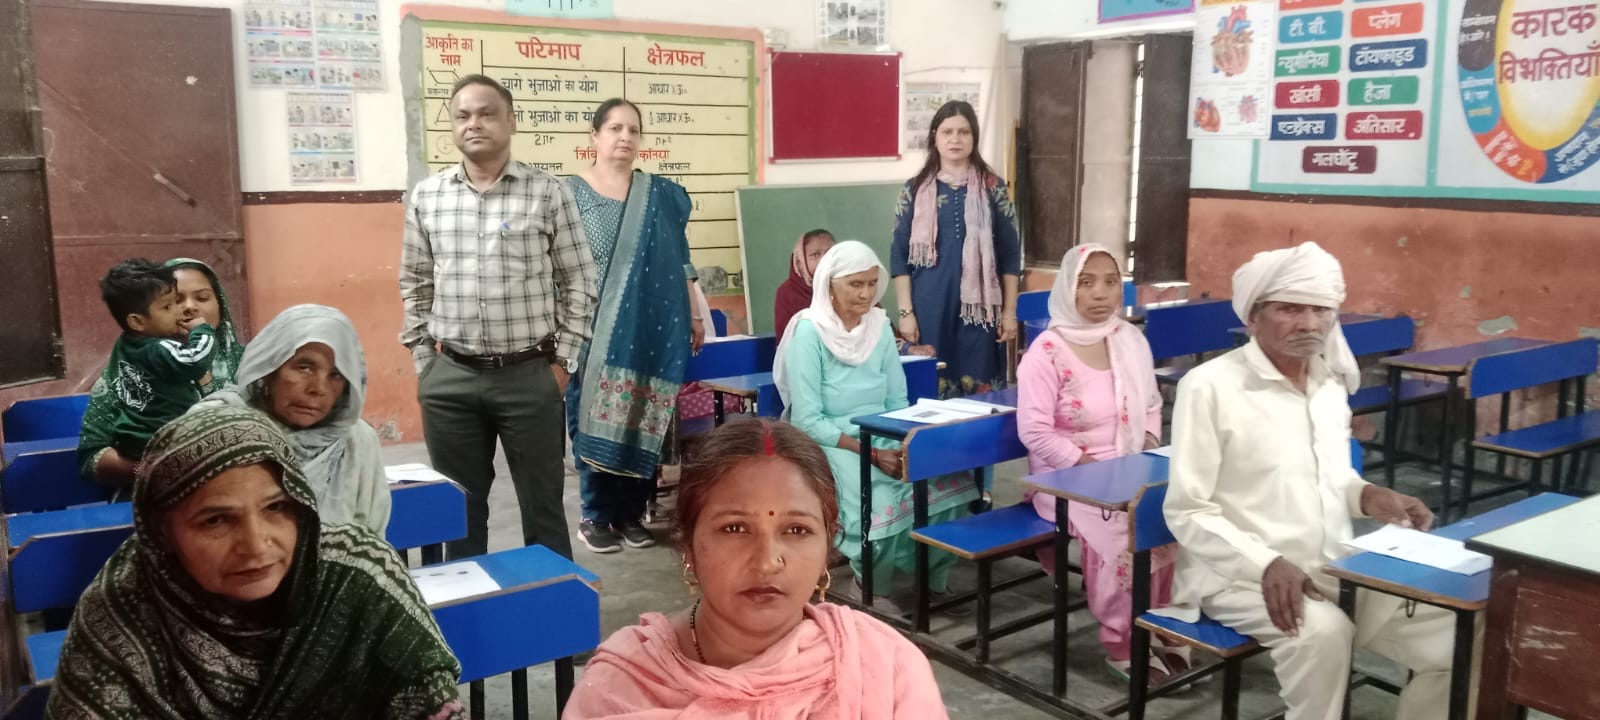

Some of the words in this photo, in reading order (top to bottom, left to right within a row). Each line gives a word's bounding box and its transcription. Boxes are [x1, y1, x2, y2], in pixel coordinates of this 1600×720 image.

[1368, 10, 1402, 29] प्लेग
[1511, 4, 1597, 38] कारक
[425, 33, 459, 52] आकृति
[461, 38, 474, 52] का
[515, 36, 582, 60] परिमाप
[440, 54, 462, 66] नाम
[647, 43, 705, 67] क्षेत्रफल
[1499, 40, 1600, 84] विभक्तियाँ
[1364, 81, 1393, 103] हैजा
[565, 112, 578, 123] का
[581, 106, 598, 123] यो
[1353, 114, 1407, 134] अतिसार
